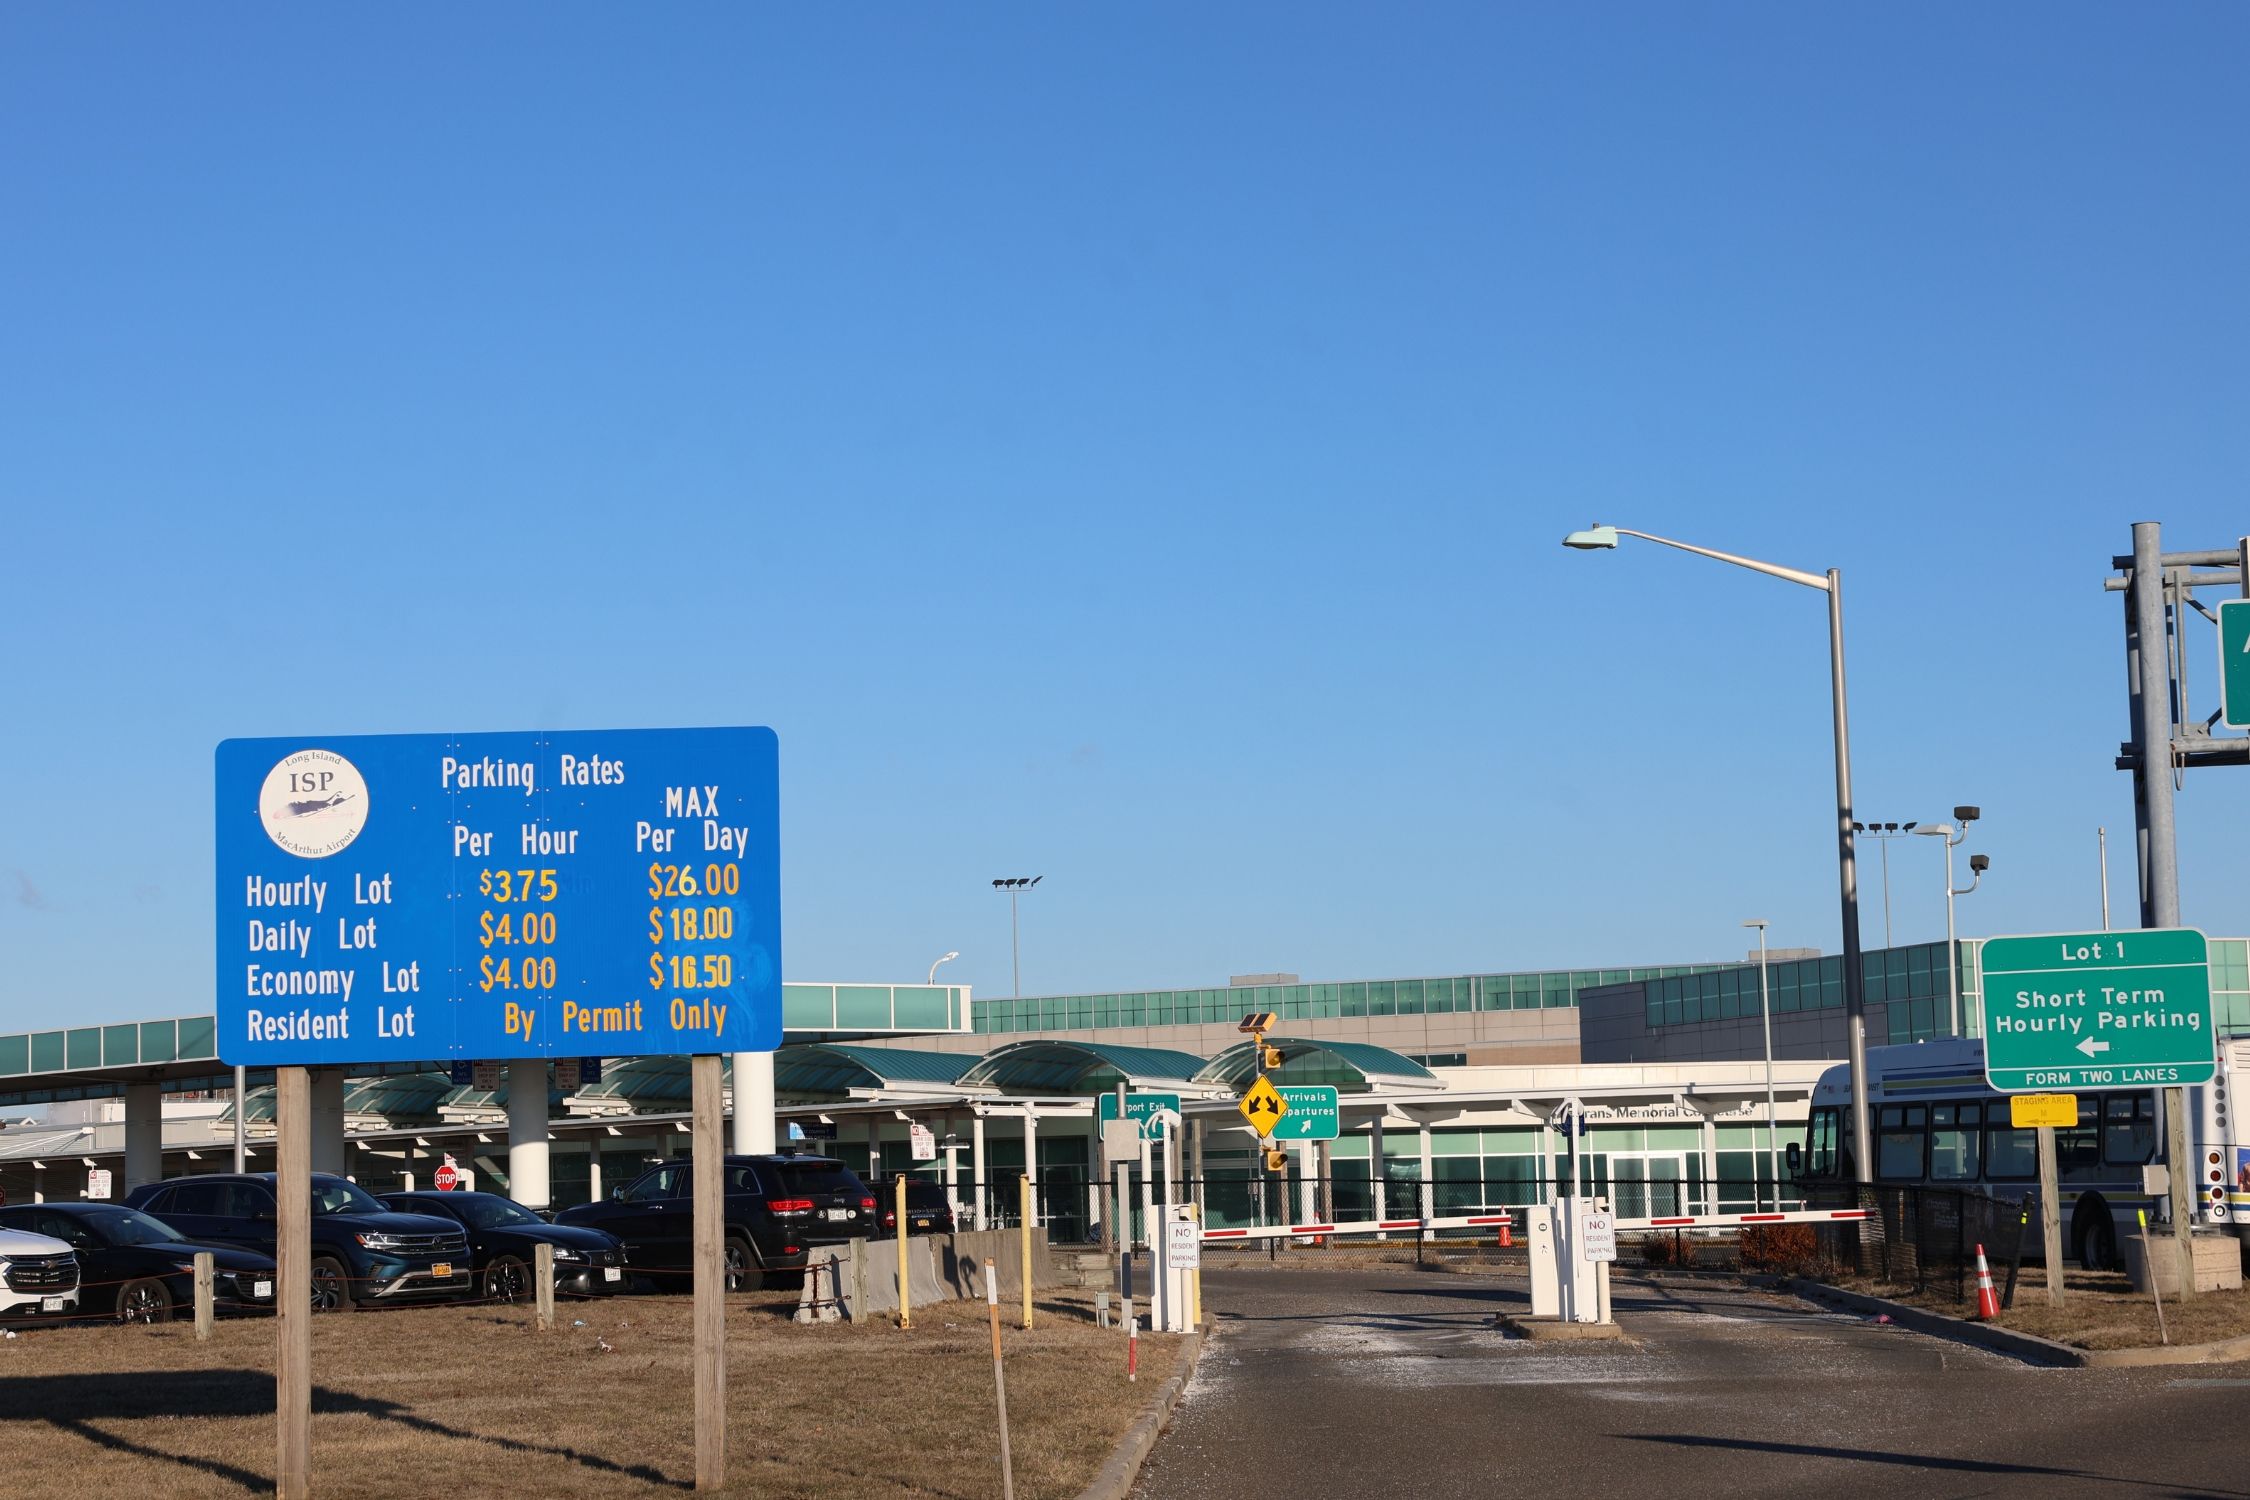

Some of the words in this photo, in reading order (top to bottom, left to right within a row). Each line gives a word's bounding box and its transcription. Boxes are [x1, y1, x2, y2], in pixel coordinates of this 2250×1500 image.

[285, 754, 310, 766] Long
[312, 751, 342, 765] Island
[289, 772, 334, 792] ISP
[443, 756, 534, 796] Parking
[562, 754, 625, 785] Rates
[667, 786, 719, 818] MAX
[275, 831, 323, 855] MacArthur
[326, 828, 356, 852] Airport
[454, 826, 493, 857] Per
[522, 824, 579, 855] Hour
[636, 821, 675, 853] Per
[704, 820, 749, 859] Day
[247, 875, 327, 913] Hourly
[355, 873, 392, 905] Lot
[479, 868, 558, 903] $3.75
[649, 862, 740, 900] $26.00
[249, 919, 312, 957] Daily
[340, 917, 377, 950] Lot
[479, 910, 557, 948] $4.00
[2062, 942, 2102, 961] Lot
[2116, 941, 2125, 958] 1
[247, 964, 355, 1002] Economy
[383, 960, 420, 993] Lot
[479, 955, 557, 992] $4.00
[2016, 989, 2086, 1009] Short
[2101, 987, 2165, 1005] Term
[248, 1008, 349, 1042] Resident
[378, 1005, 415, 1038] Lot
[505, 1003, 535, 1042] By
[563, 1000, 643, 1033] Permit
[670, 998, 727, 1037] Only
[1996, 1013, 2083, 1035] Hourly
[2098, 1009, 2200, 1031] Parking
[2026, 1072, 2071, 1085] FORM
[2080, 1070, 2112, 1083] TWO
[2122, 1068, 2178, 1081] LANES
[1149, 1102, 1165, 1112] Exit
[1282, 1092, 1326, 1102] Arrivals
[2014, 1097, 2049, 1105] STAGING
[2051, 1096, 2073, 1104] AREA
[1283, 1106, 1335, 1118] partures
[1616, 1106, 1678, 1118] Memorial
[436, 1174, 456, 1184] STOP
[1175, 1228, 1191, 1238] NO
[1589, 1220, 1605, 1230] NO
